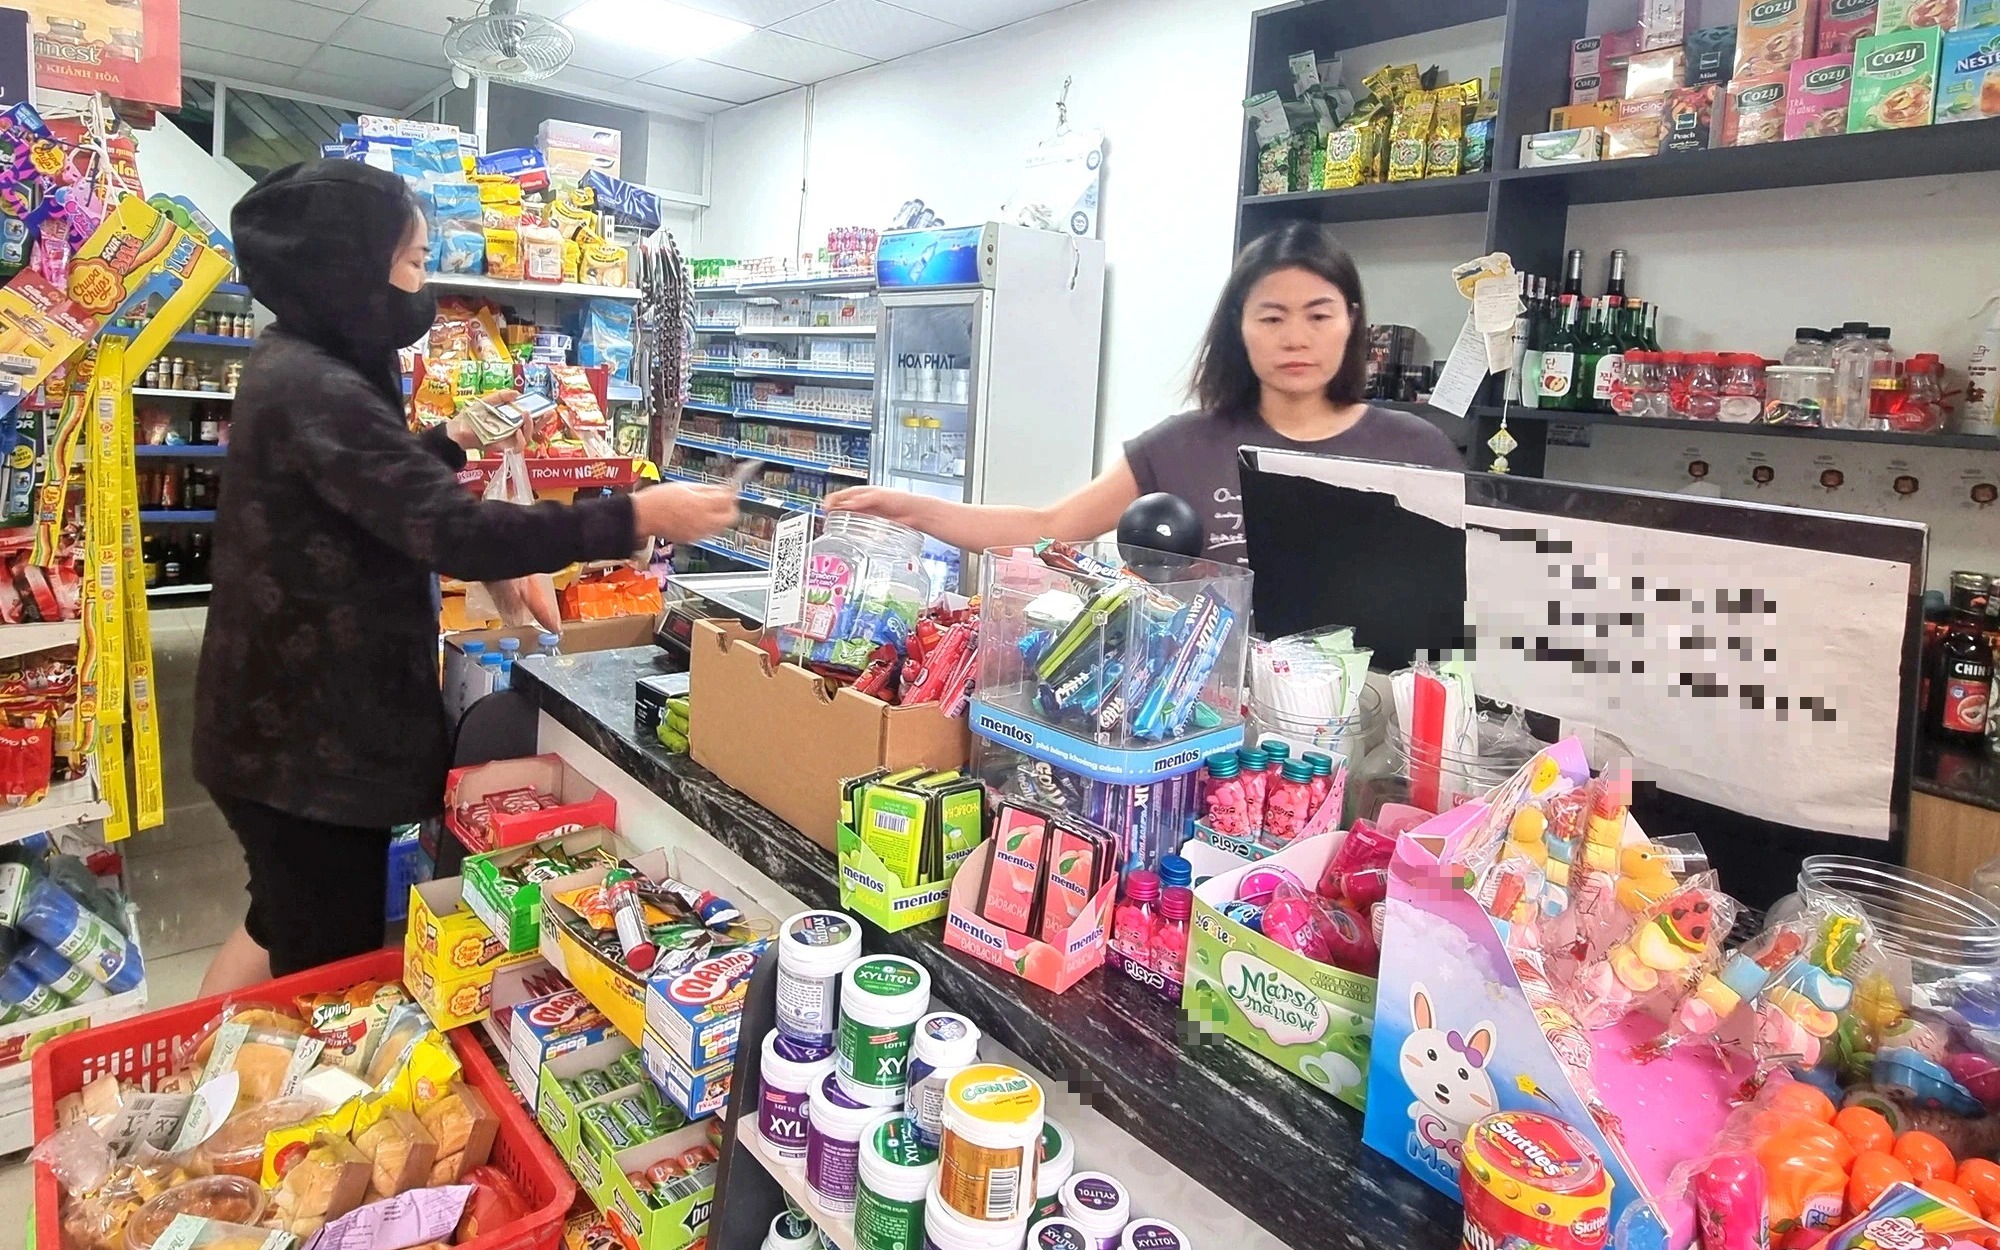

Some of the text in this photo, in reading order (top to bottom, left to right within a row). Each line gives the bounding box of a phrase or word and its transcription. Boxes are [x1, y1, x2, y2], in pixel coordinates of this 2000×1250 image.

[1755, 0, 1791, 17] Cozy
[1576, 40, 1598, 50] Cozy
[1872, 48, 1916, 67] Cozy
[1575, 78, 1597, 87] Cozy
[1810, 69, 1845, 83] Cozy
[1742, 87, 1779, 102] Cozy
[1674, 132, 1695, 140] Peach
[102, 237, 121, 262] SOUR
[73, 267, 100, 296] Chupa
[83, 277, 111, 305] Chups
[811, 571, 840, 582] trawberry
[980, 715, 1033, 745] mentos
[1154, 748, 1199, 771] mentos
[1211, 835, 1241, 854] play
[997, 851, 1035, 871] mentos
[843, 865, 884, 893] mentos
[1051, 873, 1086, 897] mentos
[893, 888, 949, 911] mentos
[950, 912, 1003, 949] mentos
[1069, 926, 1104, 953] mentos
[858, 970, 914, 985] XYLITOL
[1125, 961, 1152, 984] play
[1228, 965, 1319, 1017] Marsh
[313, 1003, 351, 1029] Swing
[1245, 998, 1317, 1035] mallow
[1006, 1079, 1028, 1092] Air
[774, 1103, 797, 1113] LOTTE
[769, 1114, 806, 1138] XYL
[1490, 1120, 1560, 1177] Skittles
[1078, 1188, 1116, 1200] XYLITOL
[1137, 1238, 1177, 1247] XYLITOL
